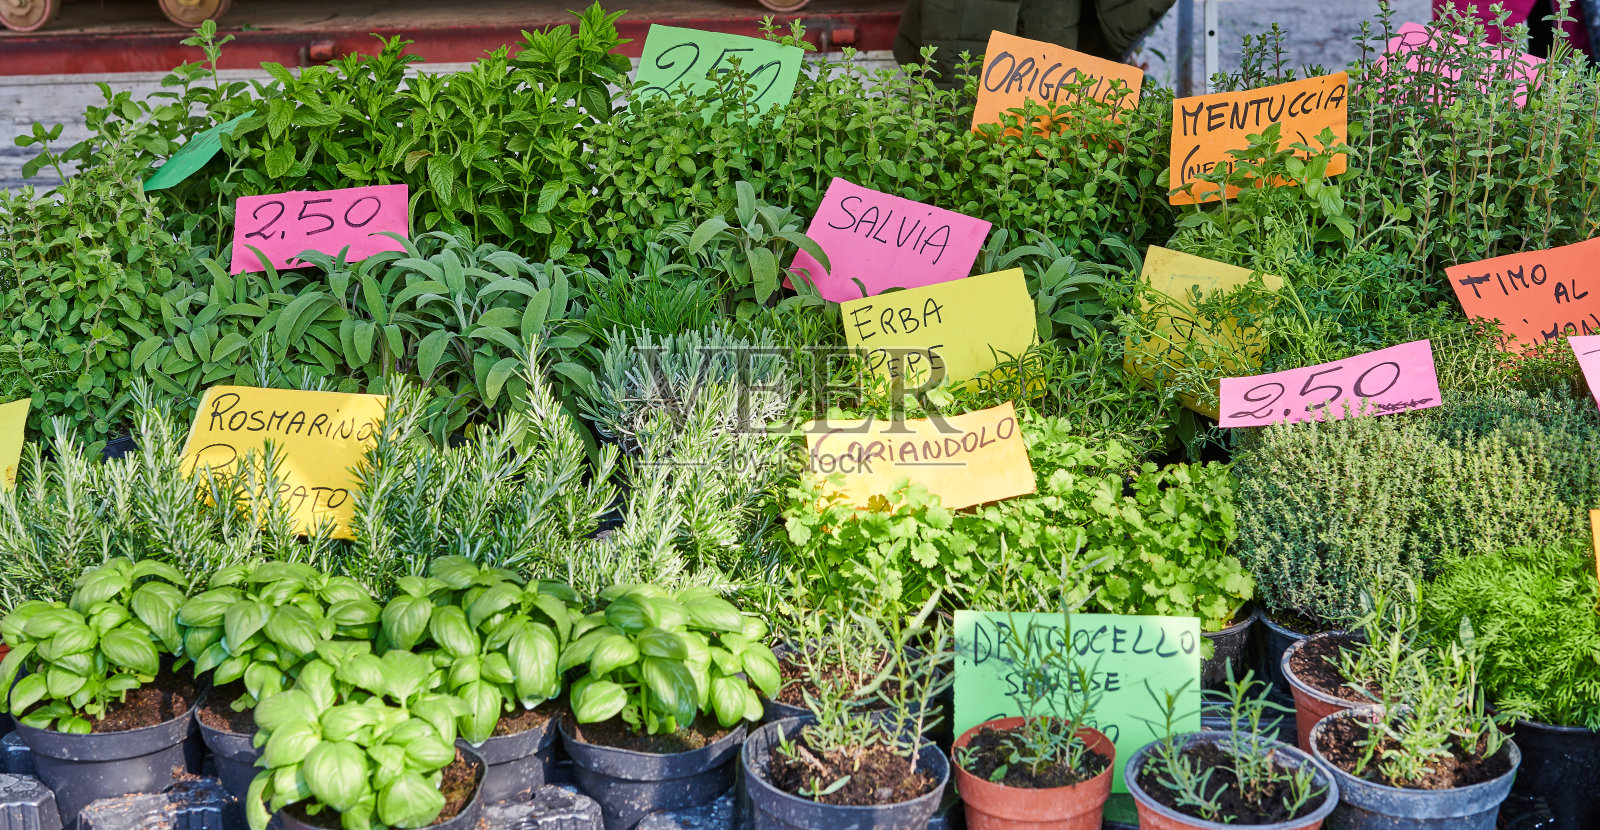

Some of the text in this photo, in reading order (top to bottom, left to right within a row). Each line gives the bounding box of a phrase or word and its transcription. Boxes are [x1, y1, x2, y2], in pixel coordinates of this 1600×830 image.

[1459, 263, 1547, 299] TIMO
[1554, 278, 1589, 304] AL
[850, 297, 944, 342] ERBA
[864, 344, 944, 382] PEPE
[1228, 361, 1401, 419] 2.50
